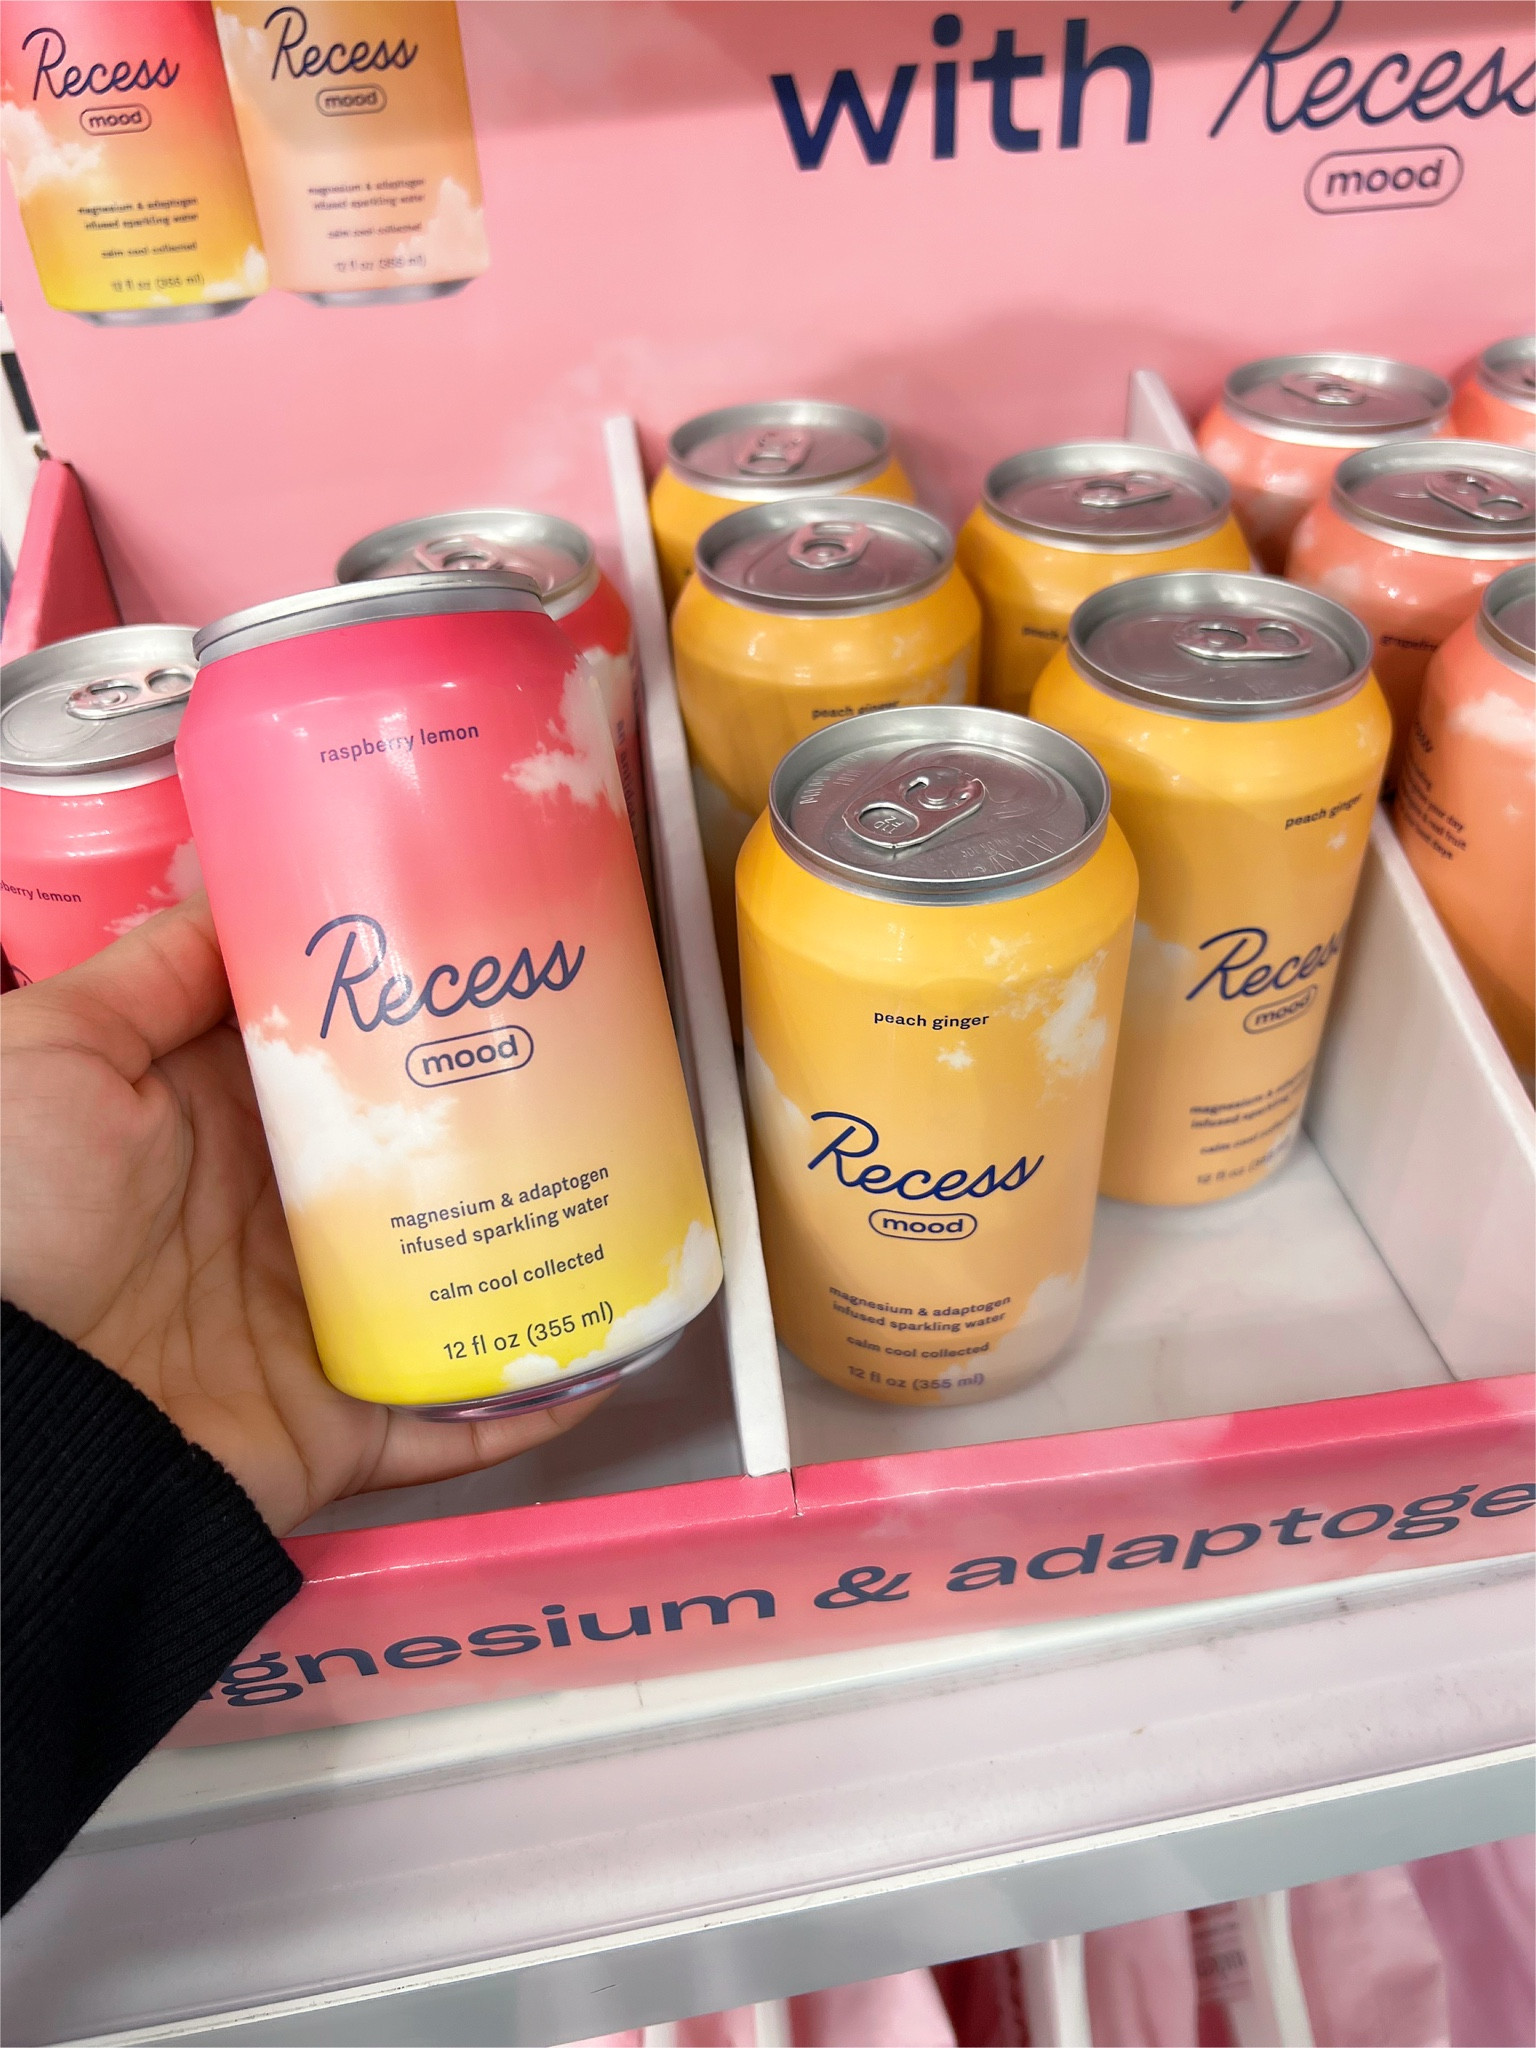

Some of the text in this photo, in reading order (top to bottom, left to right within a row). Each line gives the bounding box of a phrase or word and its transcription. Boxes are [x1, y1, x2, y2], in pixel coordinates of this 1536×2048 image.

[264, 6, 418, 80] Recess
[22, 27, 180, 100] Recess
[325, 89, 379, 109] mood
[771, 13, 1152, 171] with
[88, 109, 143, 128] mood
[1326, 158, 1444, 196] mood
[320, 725, 480, 763] raspberry lemon
[0, 880, 82, 902] berry lemon
[305, 914, 586, 1039] Recess
[873, 1010, 990, 1030] peach ginger
[422, 1034, 520, 1077] mood
[807, 1111, 1045, 1201] Recess
[390, 1166, 610, 1230] magnesium & adaptogen
[400, 1193, 610, 1255] infused sparkling water
[882, 1216, 963, 1234] mood
[429, 1243, 605, 1302] calm cool collected
[829, 1286, 1011, 1318] magnesium & adaptogen
[833, 1300, 1006, 1333] infused sparkling water
[443, 1300, 615, 1360] 12 fl oz (355 ml)
[885, 1345, 917, 1358] cool
[921, 1341, 990, 1359] collected
[848, 1365, 865, 1379] 12
[886, 1378, 907, 1389] oz
[199, 1588, 776, 1708] gnesium
[813, 1565, 911, 1610] &
